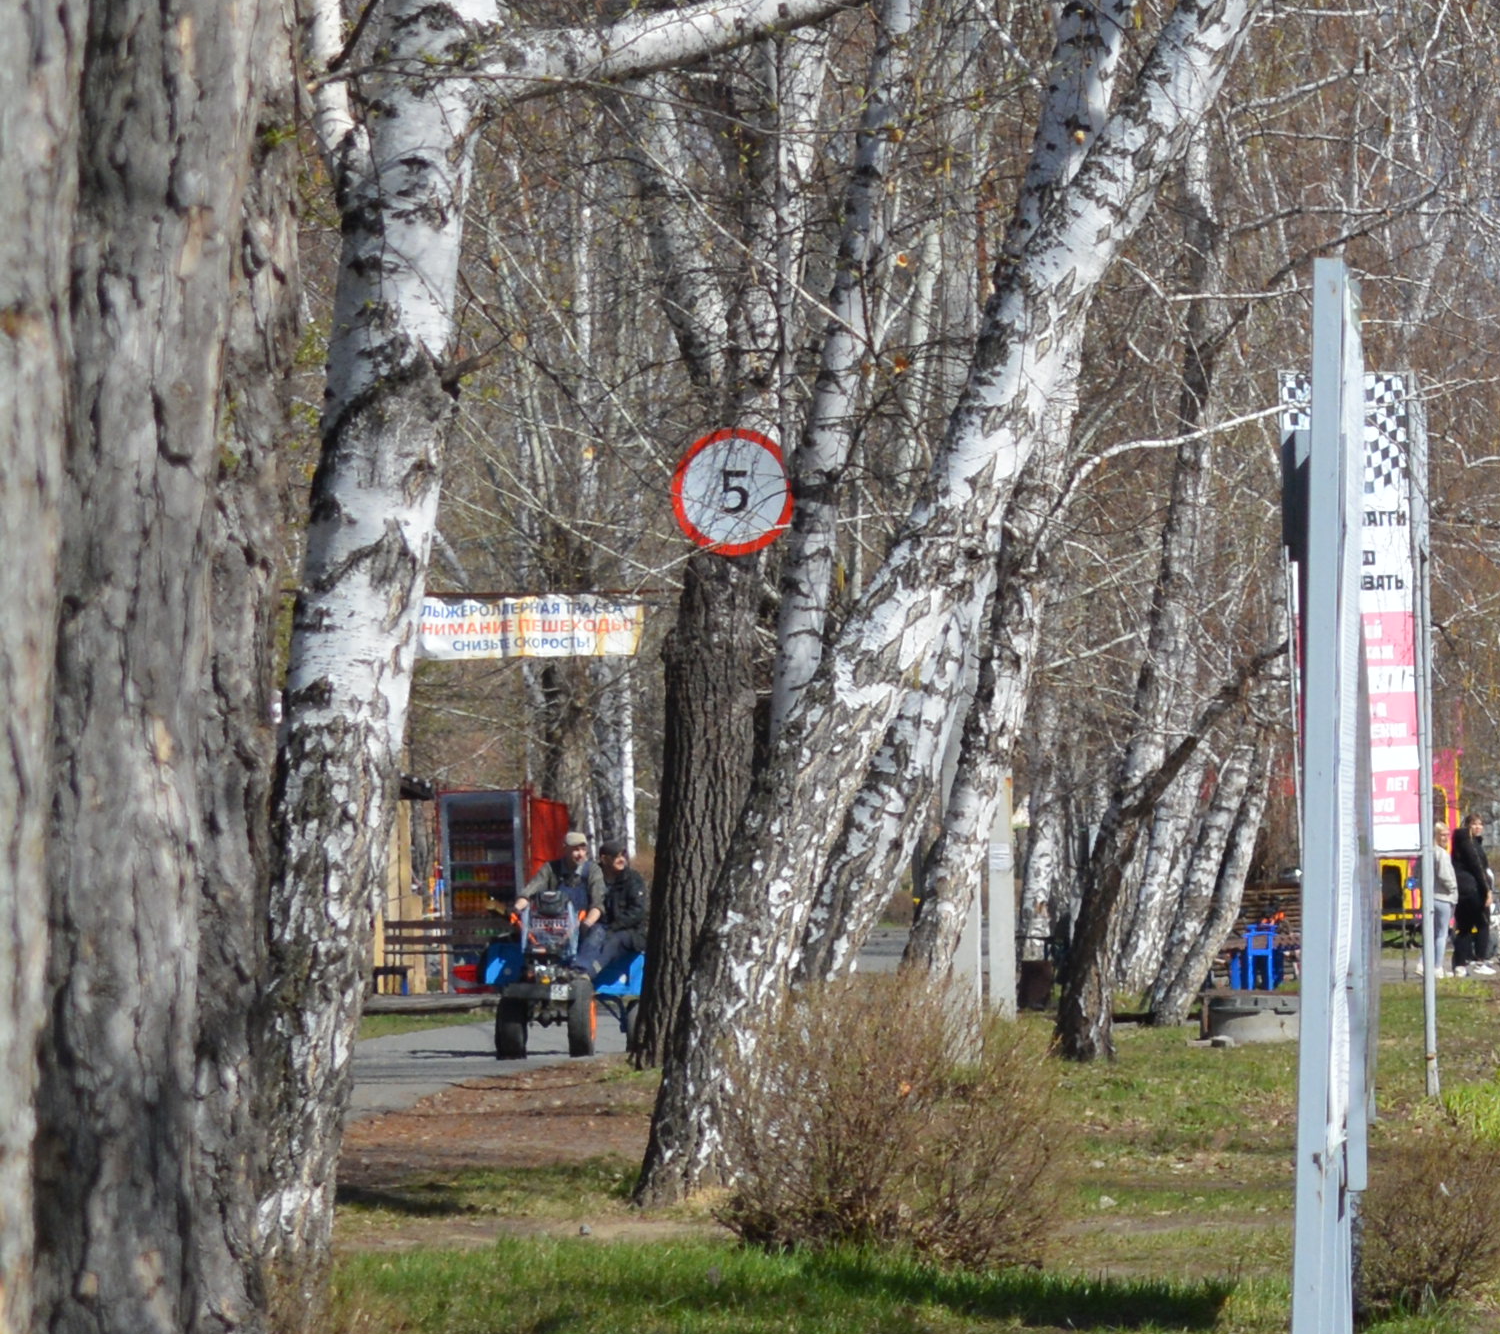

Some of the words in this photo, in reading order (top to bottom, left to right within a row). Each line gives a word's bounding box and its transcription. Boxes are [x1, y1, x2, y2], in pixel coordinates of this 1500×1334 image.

[721, 470, 748, 513] 5
[1362, 510, 1406, 527] АГГИ
[1360, 574, 1404, 590] ВАТЬ
[417, 619, 514, 635] НИМАНИЕ
[452, 638, 510, 652] СНИЗЬТЕ
[514, 637, 591, 649] СКОРОСТЬ!
